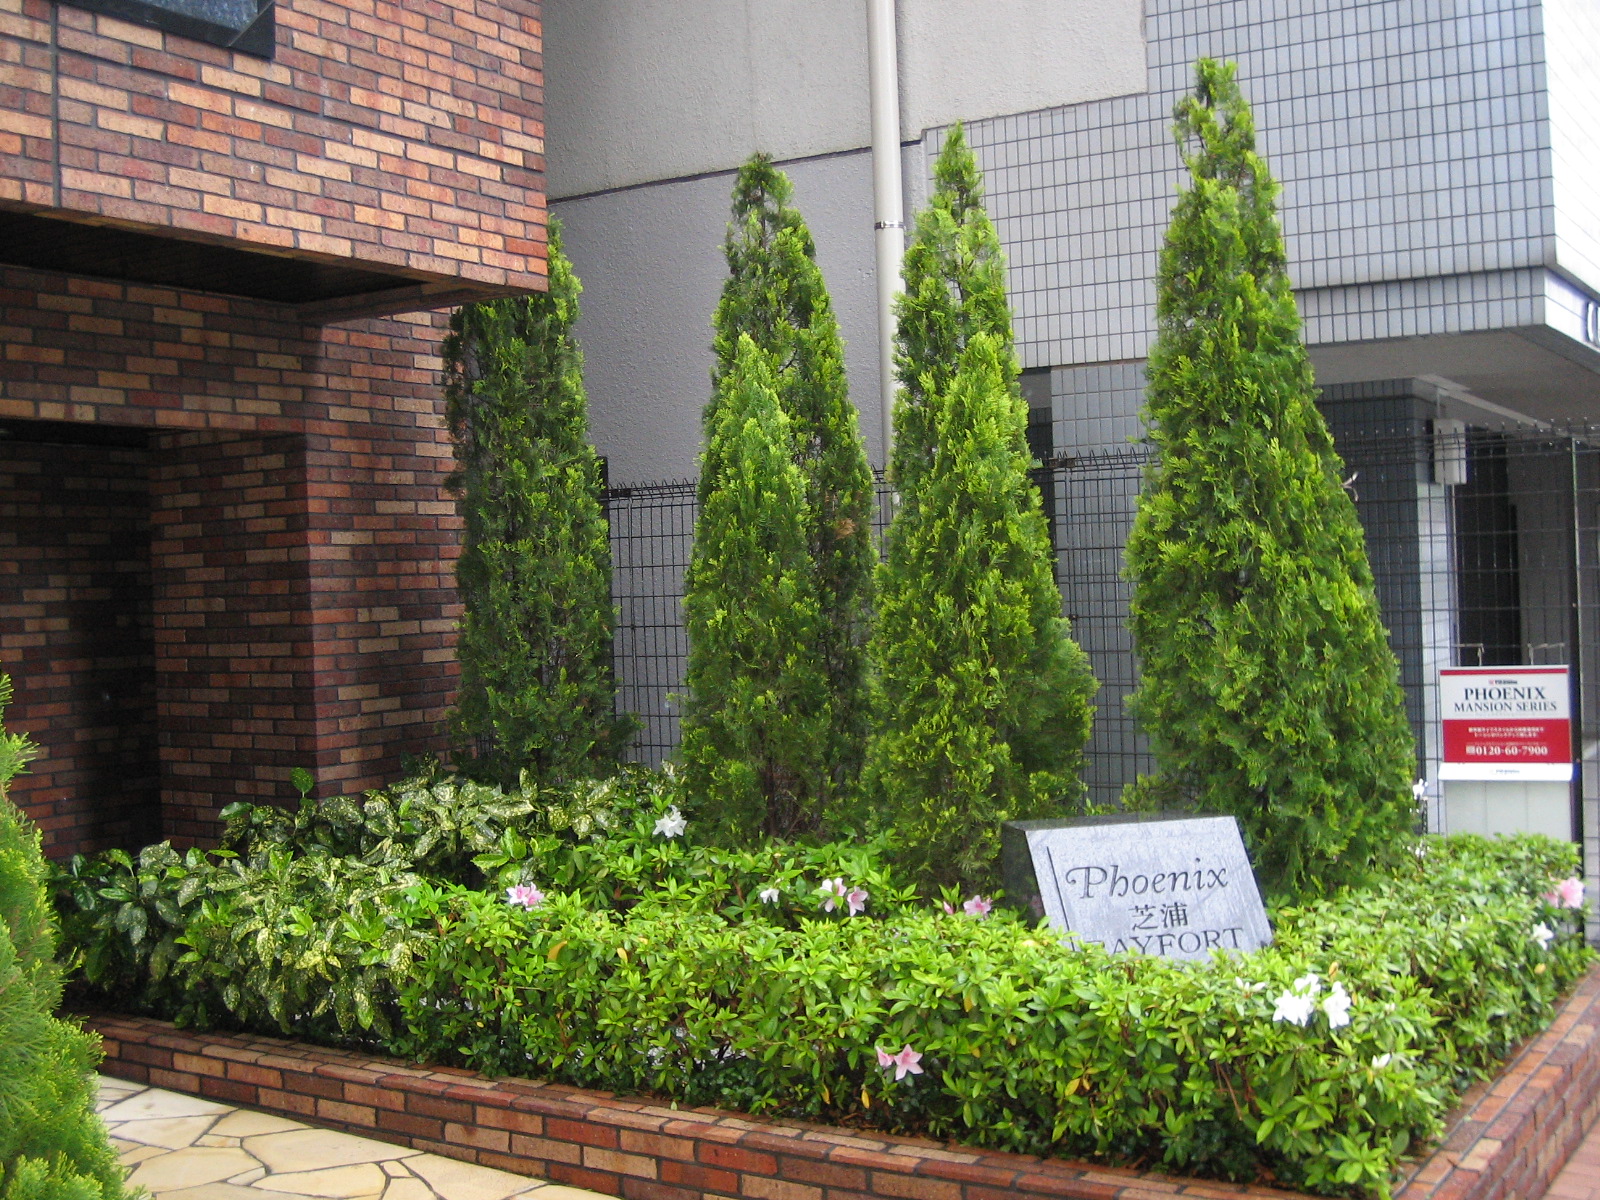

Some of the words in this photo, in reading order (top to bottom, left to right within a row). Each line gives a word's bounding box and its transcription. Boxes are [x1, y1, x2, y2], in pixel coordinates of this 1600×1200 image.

[1454, 702, 1513, 713] MANSION
[1516, 701, 1557, 712] SERIES
[1464, 687, 1546, 700] PHOENIX
[1065, 857, 1229, 899] Phoenix
[1128, 902, 1189, 931] 芝浦
[1085, 927, 1244, 956] AYFORT
